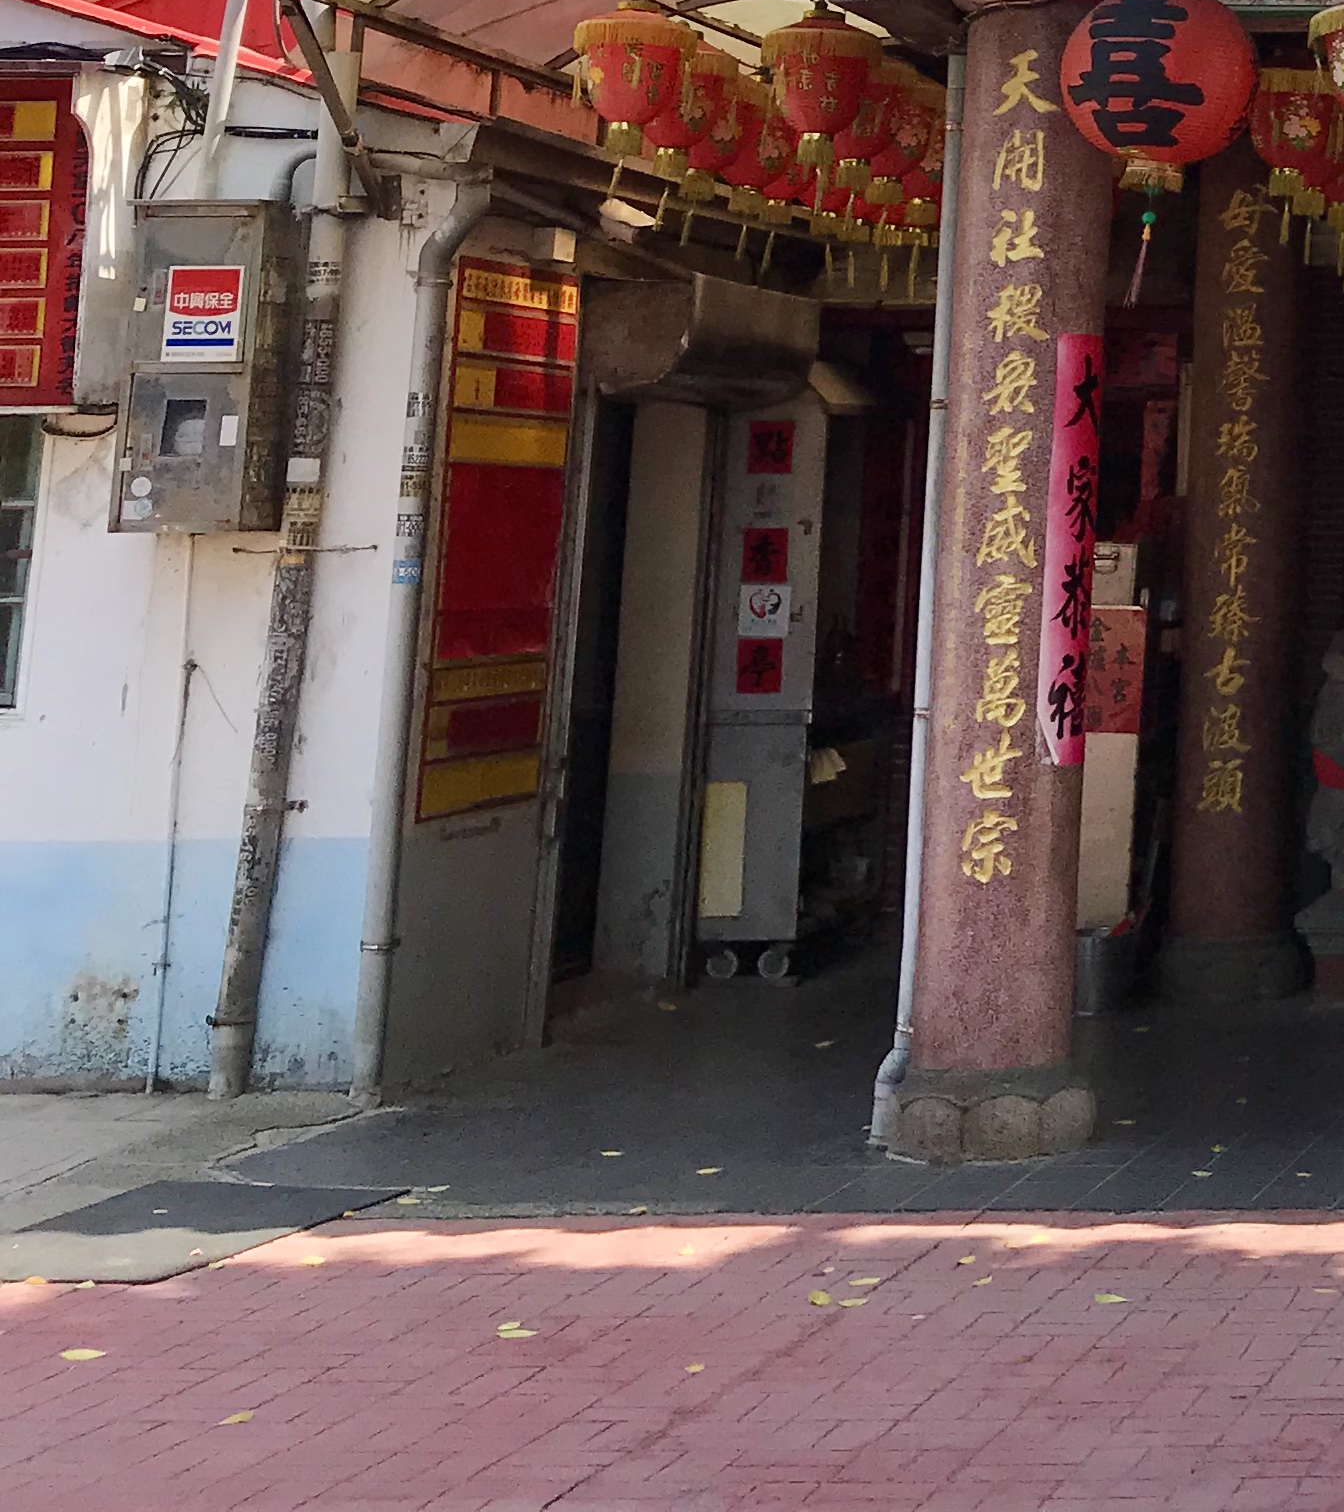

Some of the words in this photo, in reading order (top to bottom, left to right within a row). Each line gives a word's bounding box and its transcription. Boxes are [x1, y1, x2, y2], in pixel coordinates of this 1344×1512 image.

[173, 291, 235, 310] 中興保全
[171, 320, 233, 336] SECOM
